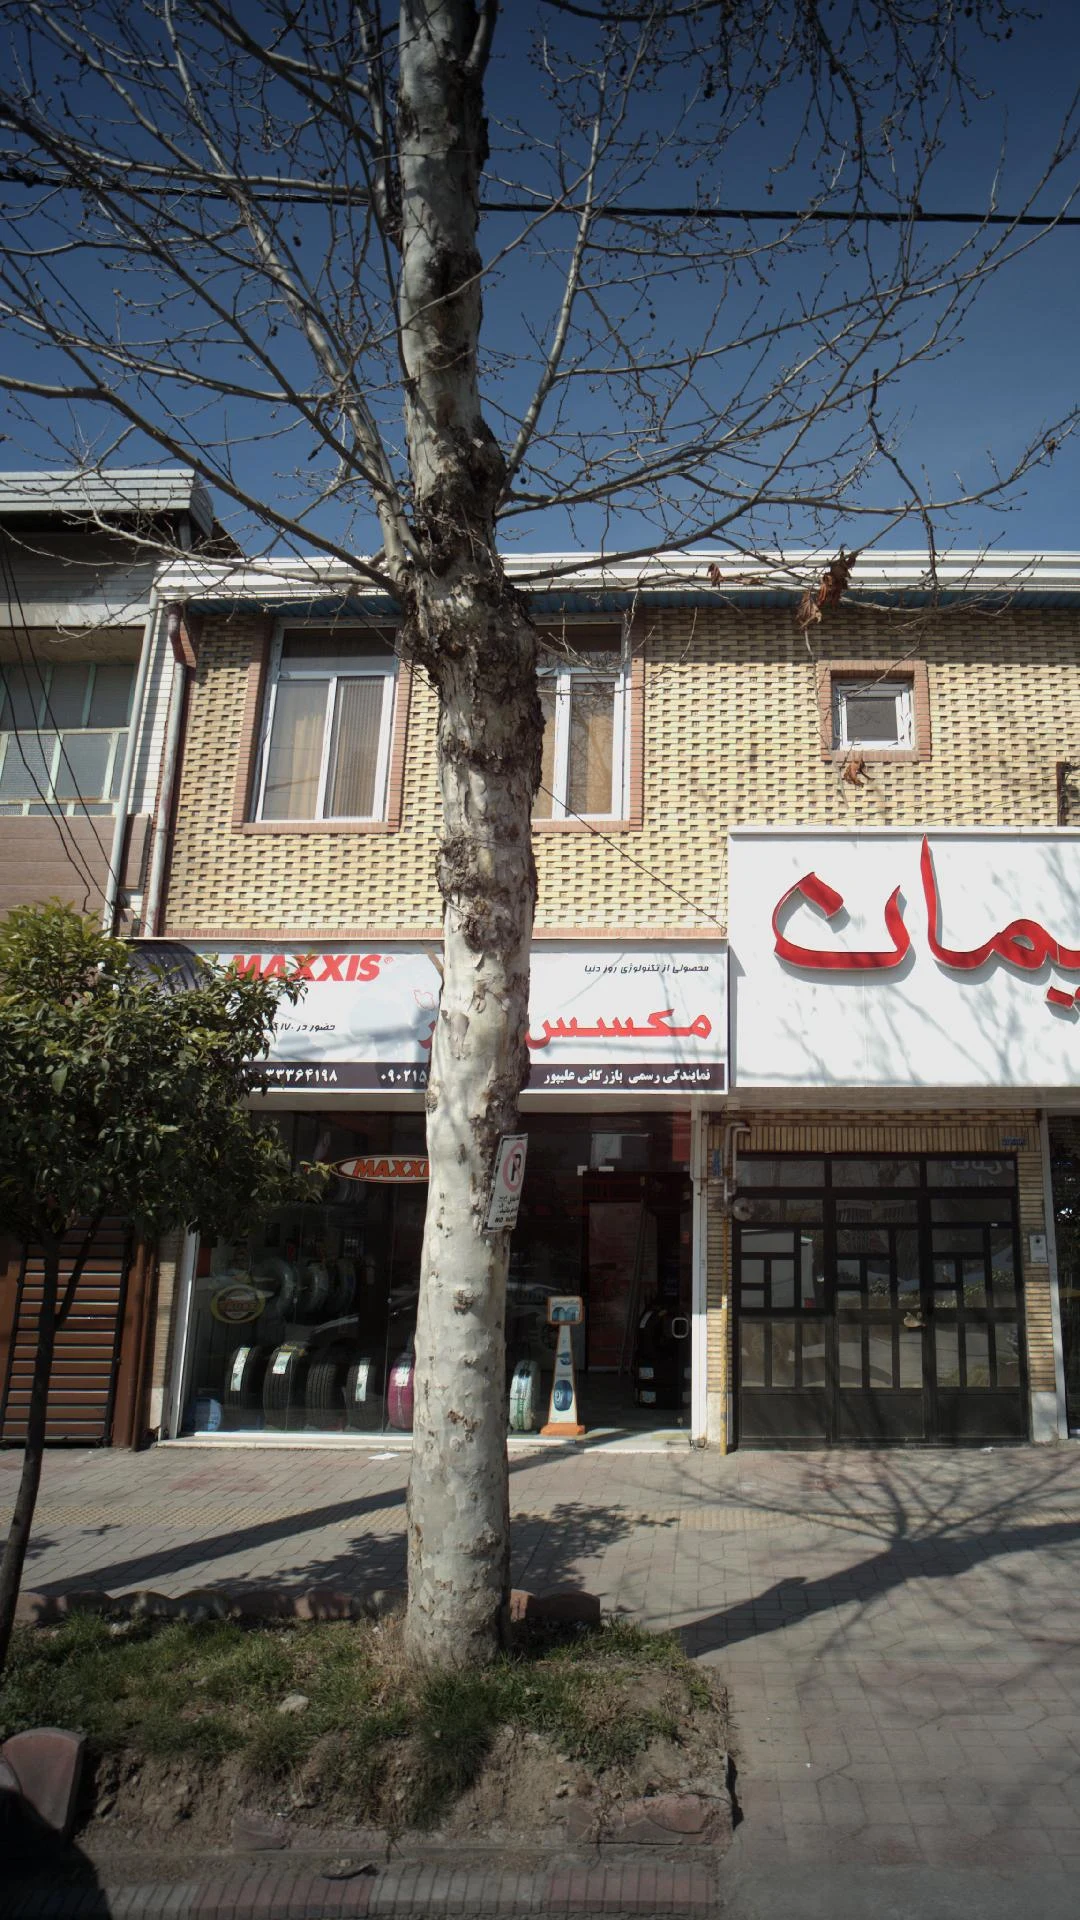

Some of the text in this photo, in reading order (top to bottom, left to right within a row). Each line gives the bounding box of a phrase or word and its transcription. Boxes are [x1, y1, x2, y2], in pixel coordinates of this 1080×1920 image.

[584, 962, 709, 975] محصولی از تکنولوژی روز دنیا
[296, 1024, 308, 1032] در
[309, 1022, 336, 1032] حضور
[380, 1068, 428, 1083] ۰۹۰۲۱۵
[543, 1068, 711, 1085] نمایندگی رسمی بازرگانی علیپور
[351, 1159, 430, 1178] MAXXI
